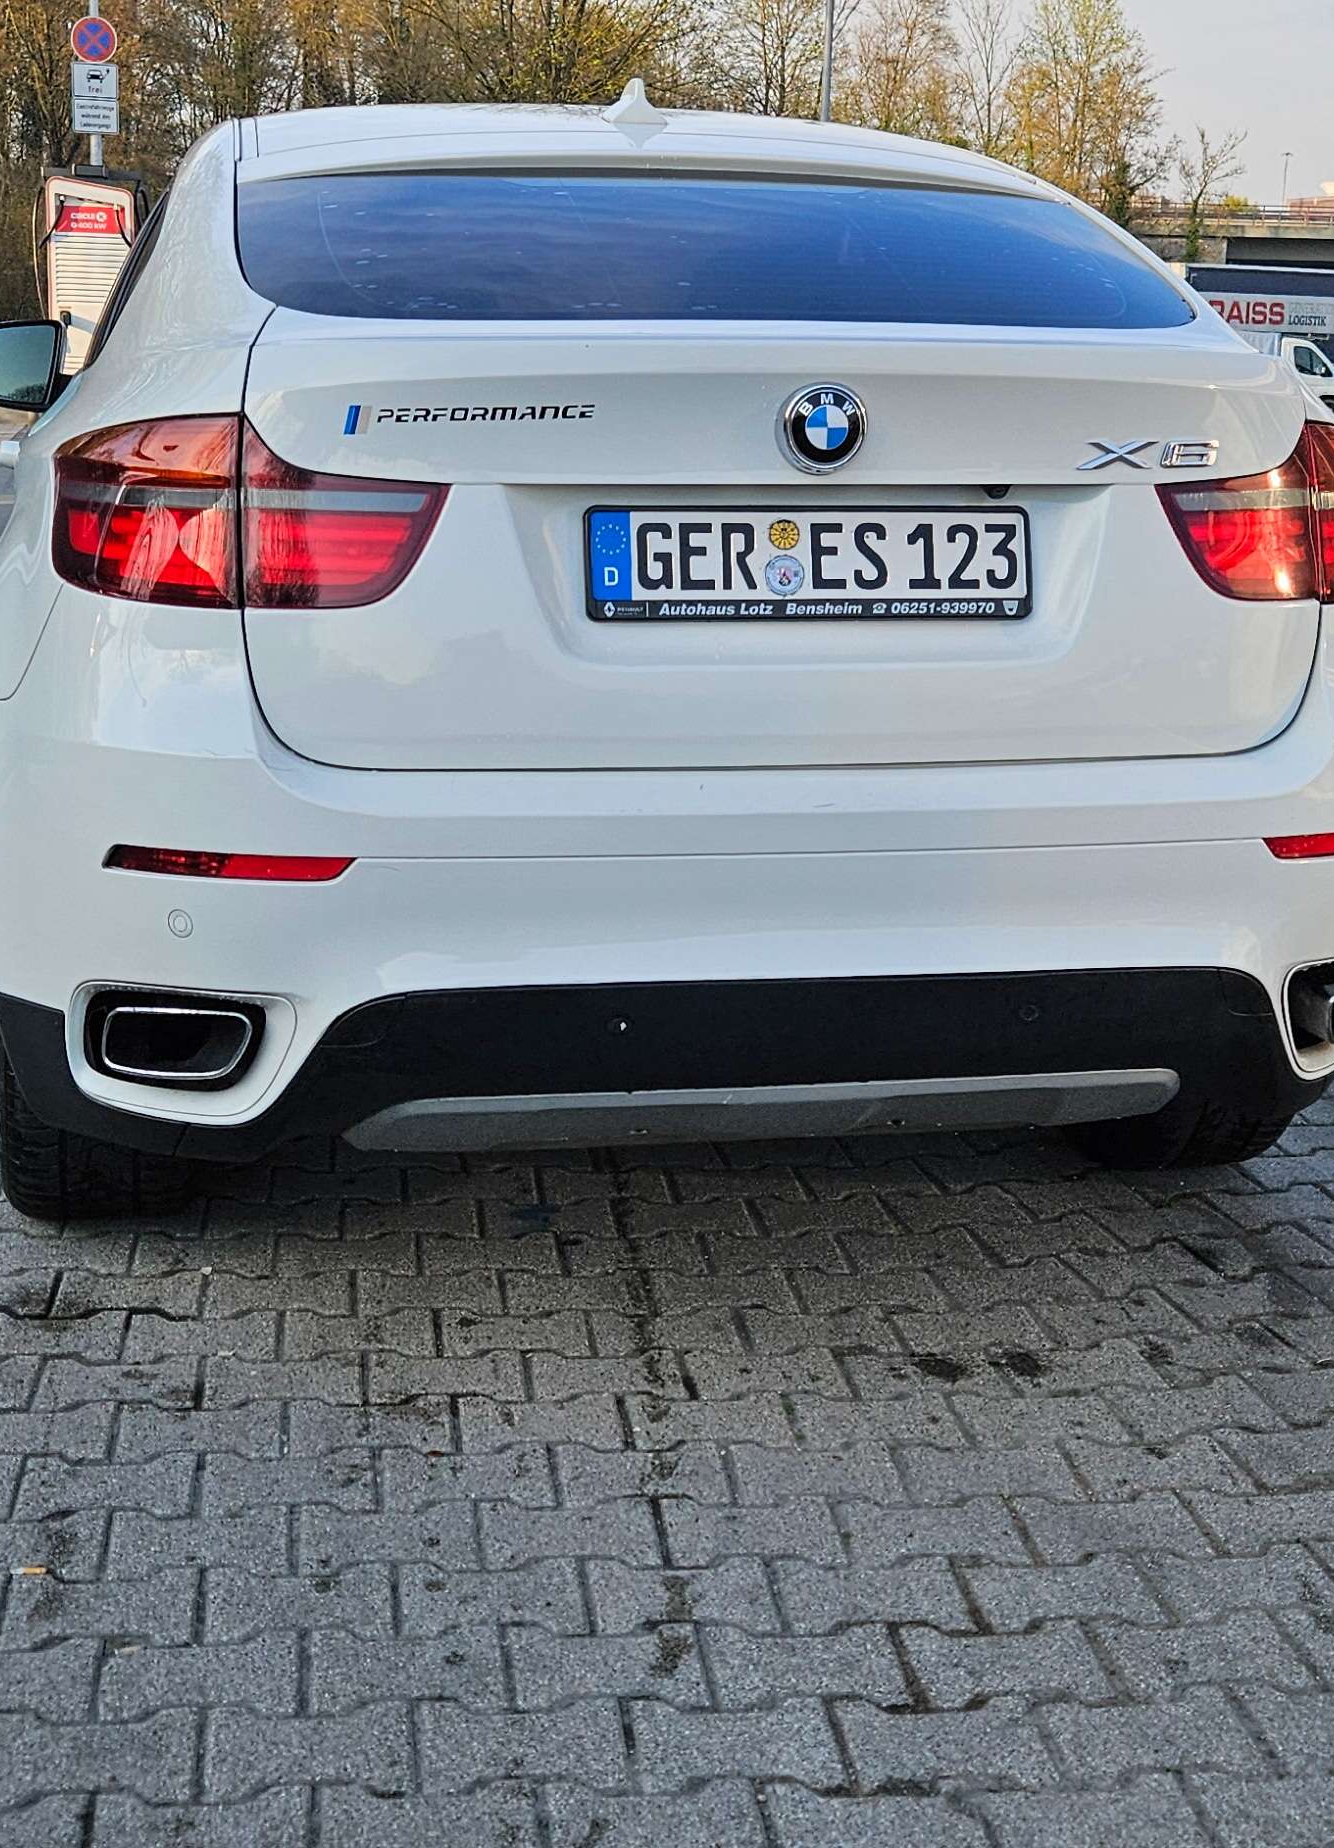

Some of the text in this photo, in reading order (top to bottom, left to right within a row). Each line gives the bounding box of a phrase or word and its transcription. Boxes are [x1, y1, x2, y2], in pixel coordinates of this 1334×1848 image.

[1288, 314, 1327, 327] LOGISTIK
[377, 404, 595, 423] PERFORMANCE
[798, 393, 856, 417] BMW
[1076, 439, 1220, 470] X6
[636, 522, 1018, 591] GER ES 123
[604, 567, 618, 586] D
[659, 602, 736, 616] Autohaus
[740, 602, 774, 616] Lotz
[785, 602, 863, 615] Bensheim
[890, 601, 995, 615] 06251-939970
